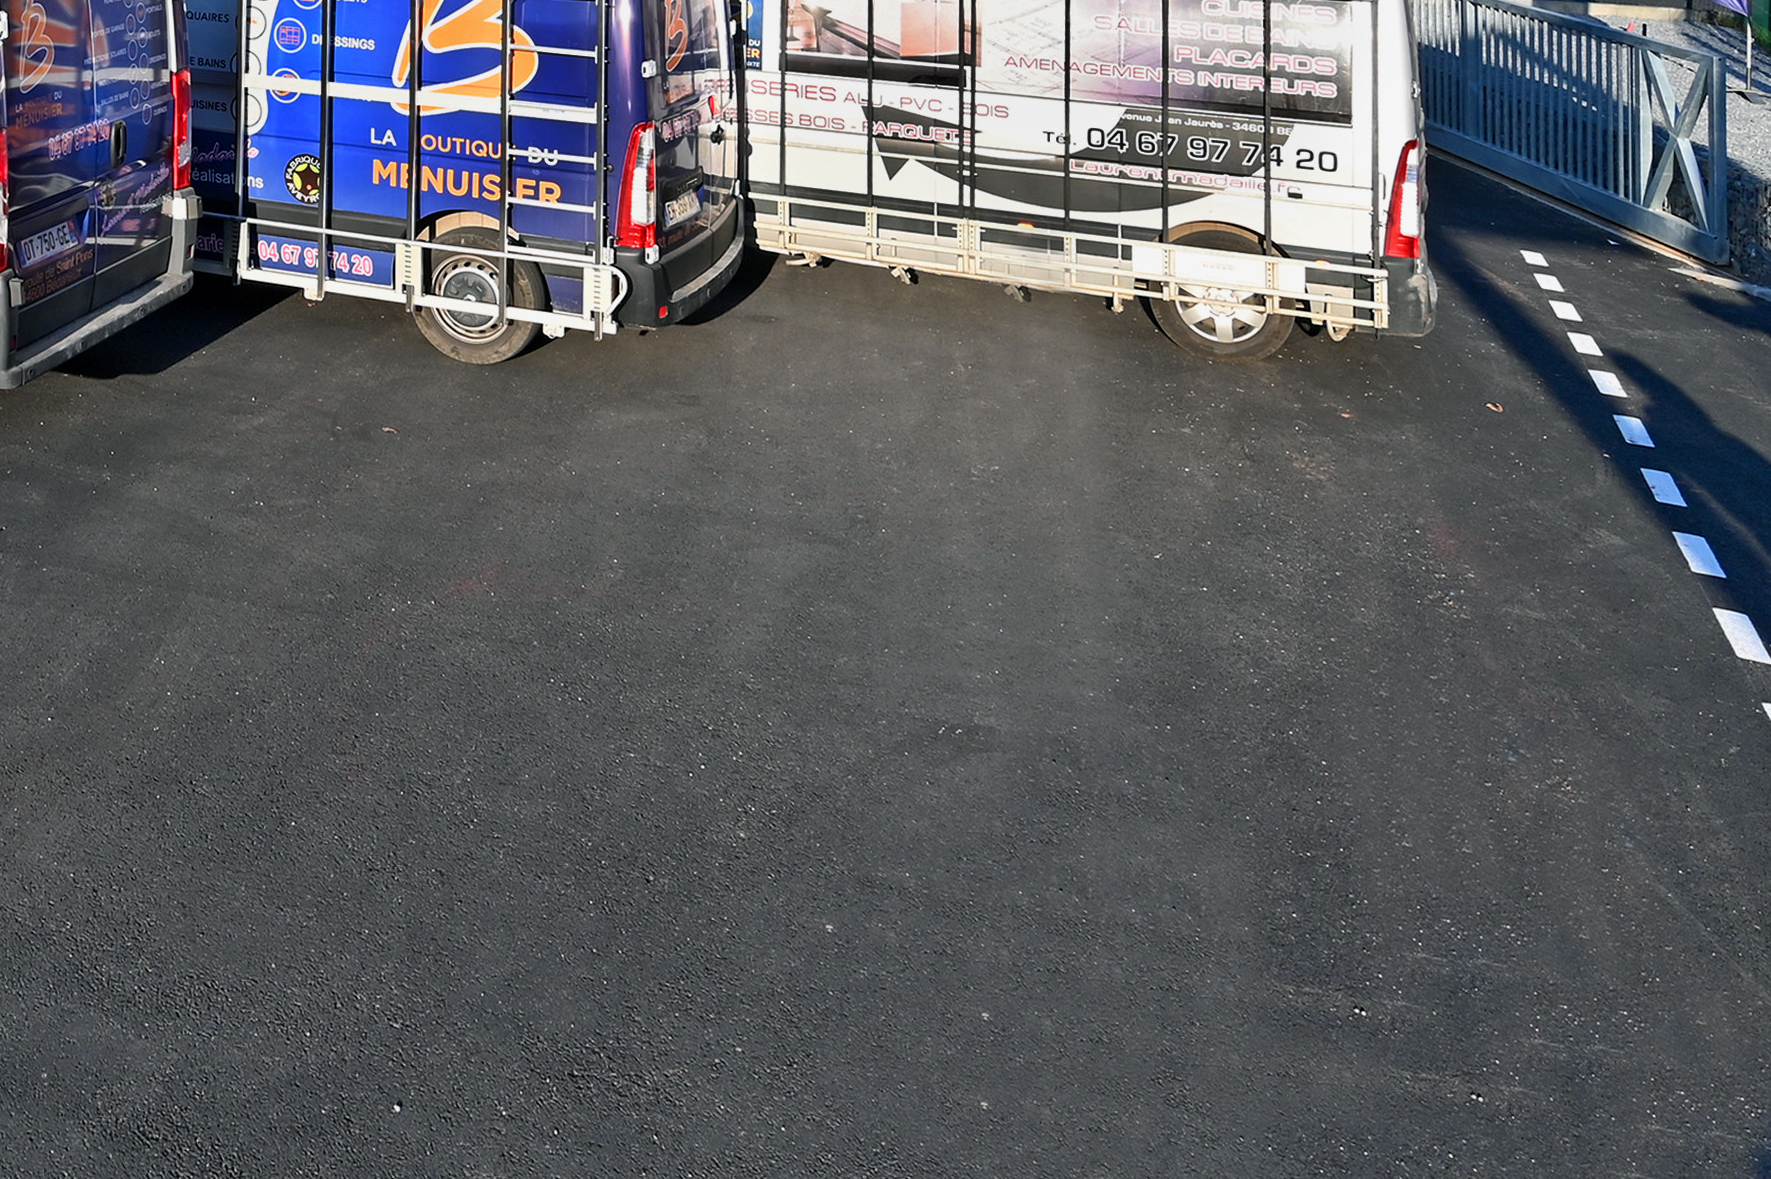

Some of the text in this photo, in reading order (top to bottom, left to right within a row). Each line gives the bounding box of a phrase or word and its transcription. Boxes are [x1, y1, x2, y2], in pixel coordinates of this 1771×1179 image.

[748, 38, 761, 47] DU
[1203, 24, 1243, 41] DE
[198, 57, 227, 69] BAINS
[1175, 45, 1337, 75] PLACARDS
[54, 91, 63, 100] DU
[1197, 71, 1337, 98] INTEREURS
[900, 96, 943, 112] PVC
[799, 114, 845, 130] BOIS
[370, 127, 559, 166] LA DU
[1086, 127, 1339, 172] 04 67 97 74 20
[23, 224, 70, 261] DT-750-GE
[258, 240, 279, 263] 04
[281, 246, 300, 265] 67
[351, 256, 373, 277] 20
